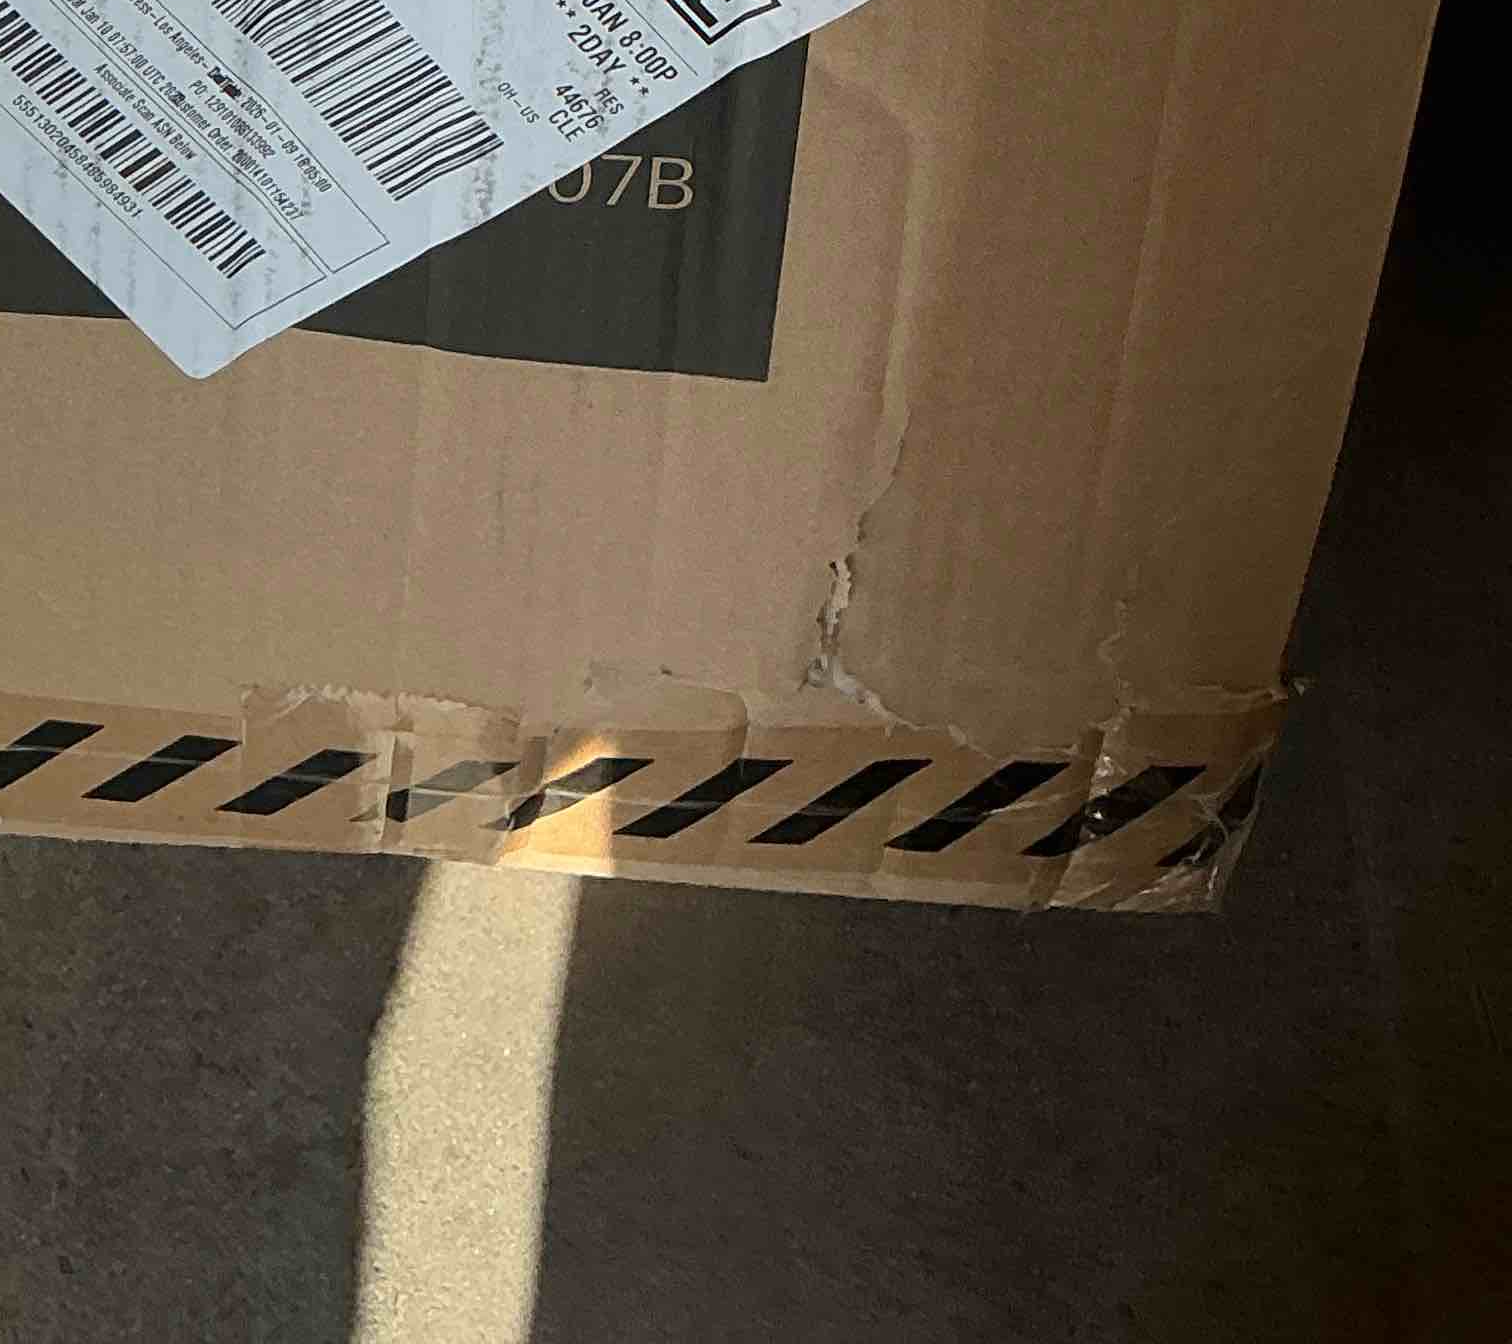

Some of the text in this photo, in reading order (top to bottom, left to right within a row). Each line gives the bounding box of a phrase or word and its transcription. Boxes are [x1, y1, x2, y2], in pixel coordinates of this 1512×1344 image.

[79, 5, 101, 26] Jan
[95, 20, 115, 37] 10
[141, 64, 167, 86] UTC
[566, 23, 627, 79] 2DAY
[618, 29, 679, 81] 8:00P
[547, 108, 586, 144] CLE
[555, 84, 606, 130] 44676
[592, 86, 626, 116] RES
[131, 97, 156, 123] Scan
[150, 117, 177, 139] ASN
[168, 132, 198, 161] Below
